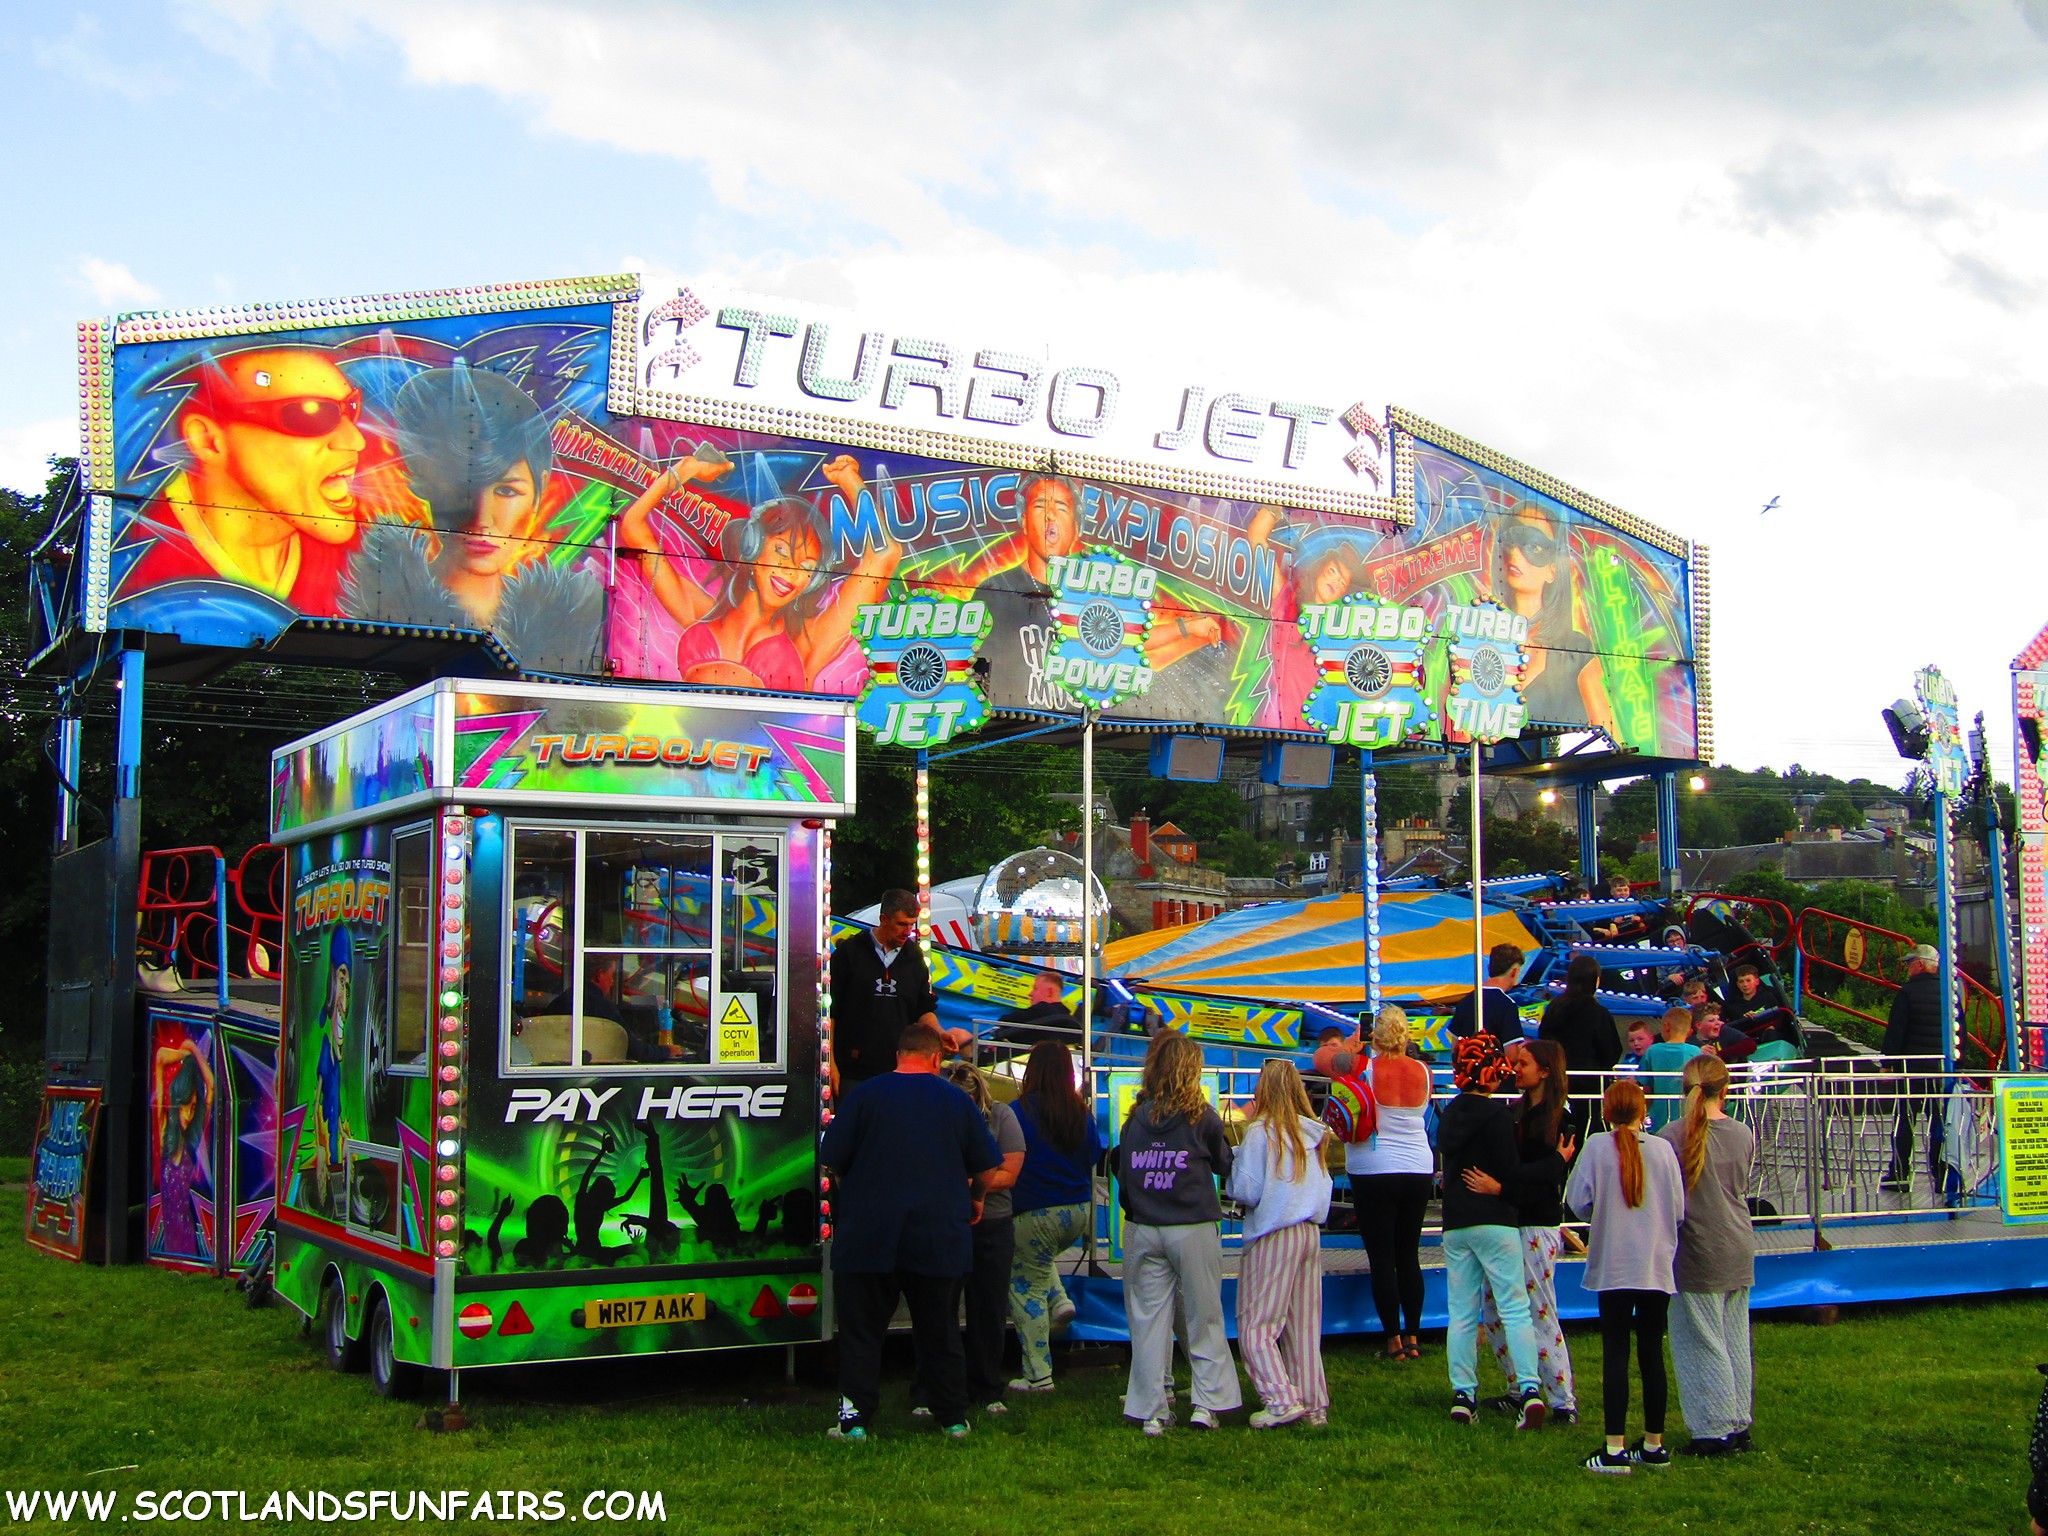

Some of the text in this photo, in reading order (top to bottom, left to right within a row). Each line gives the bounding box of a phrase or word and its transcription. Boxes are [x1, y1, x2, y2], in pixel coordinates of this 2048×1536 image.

[716, 306, 1335, 469] TURBO JET
[663, 484, 732, 547] RUSH
[831, 473, 1276, 611] MUSIC EXPLOSION
[1048, 555, 1158, 599] TURBO
[1373, 532, 1478, 600] EXTREME
[858, 602, 986, 639] TURBO
[1305, 603, 1426, 640] TURBO
[1447, 604, 1528, 642] TURBO
[1595, 545, 1653, 741] ULTIMATE
[1044, 655, 1153, 694] POWER
[1914, 670, 1957, 707] TURBO
[875, 701, 964, 743] JET
[1327, 702, 1412, 744] JET
[1451, 698, 1524, 738] TIME
[530, 733, 772, 772] TURBOJET
[1935, 757, 1962, 795] JET
[352, 860, 360, 869] THE
[361, 860, 376, 869] TURBO
[295, 879, 390, 936] TURBOJET
[720, 1049, 755, 1058] operation
[723, 1030, 749, 1039] CCTV
[733, 1040, 740, 1048] in
[504, 1084, 788, 1123] PAY HERE
[1131, 1150, 1189, 1169] WHITE
[1143, 1171, 1176, 1190] FOX
[599, 1297, 694, 1324] WR17 AAK
